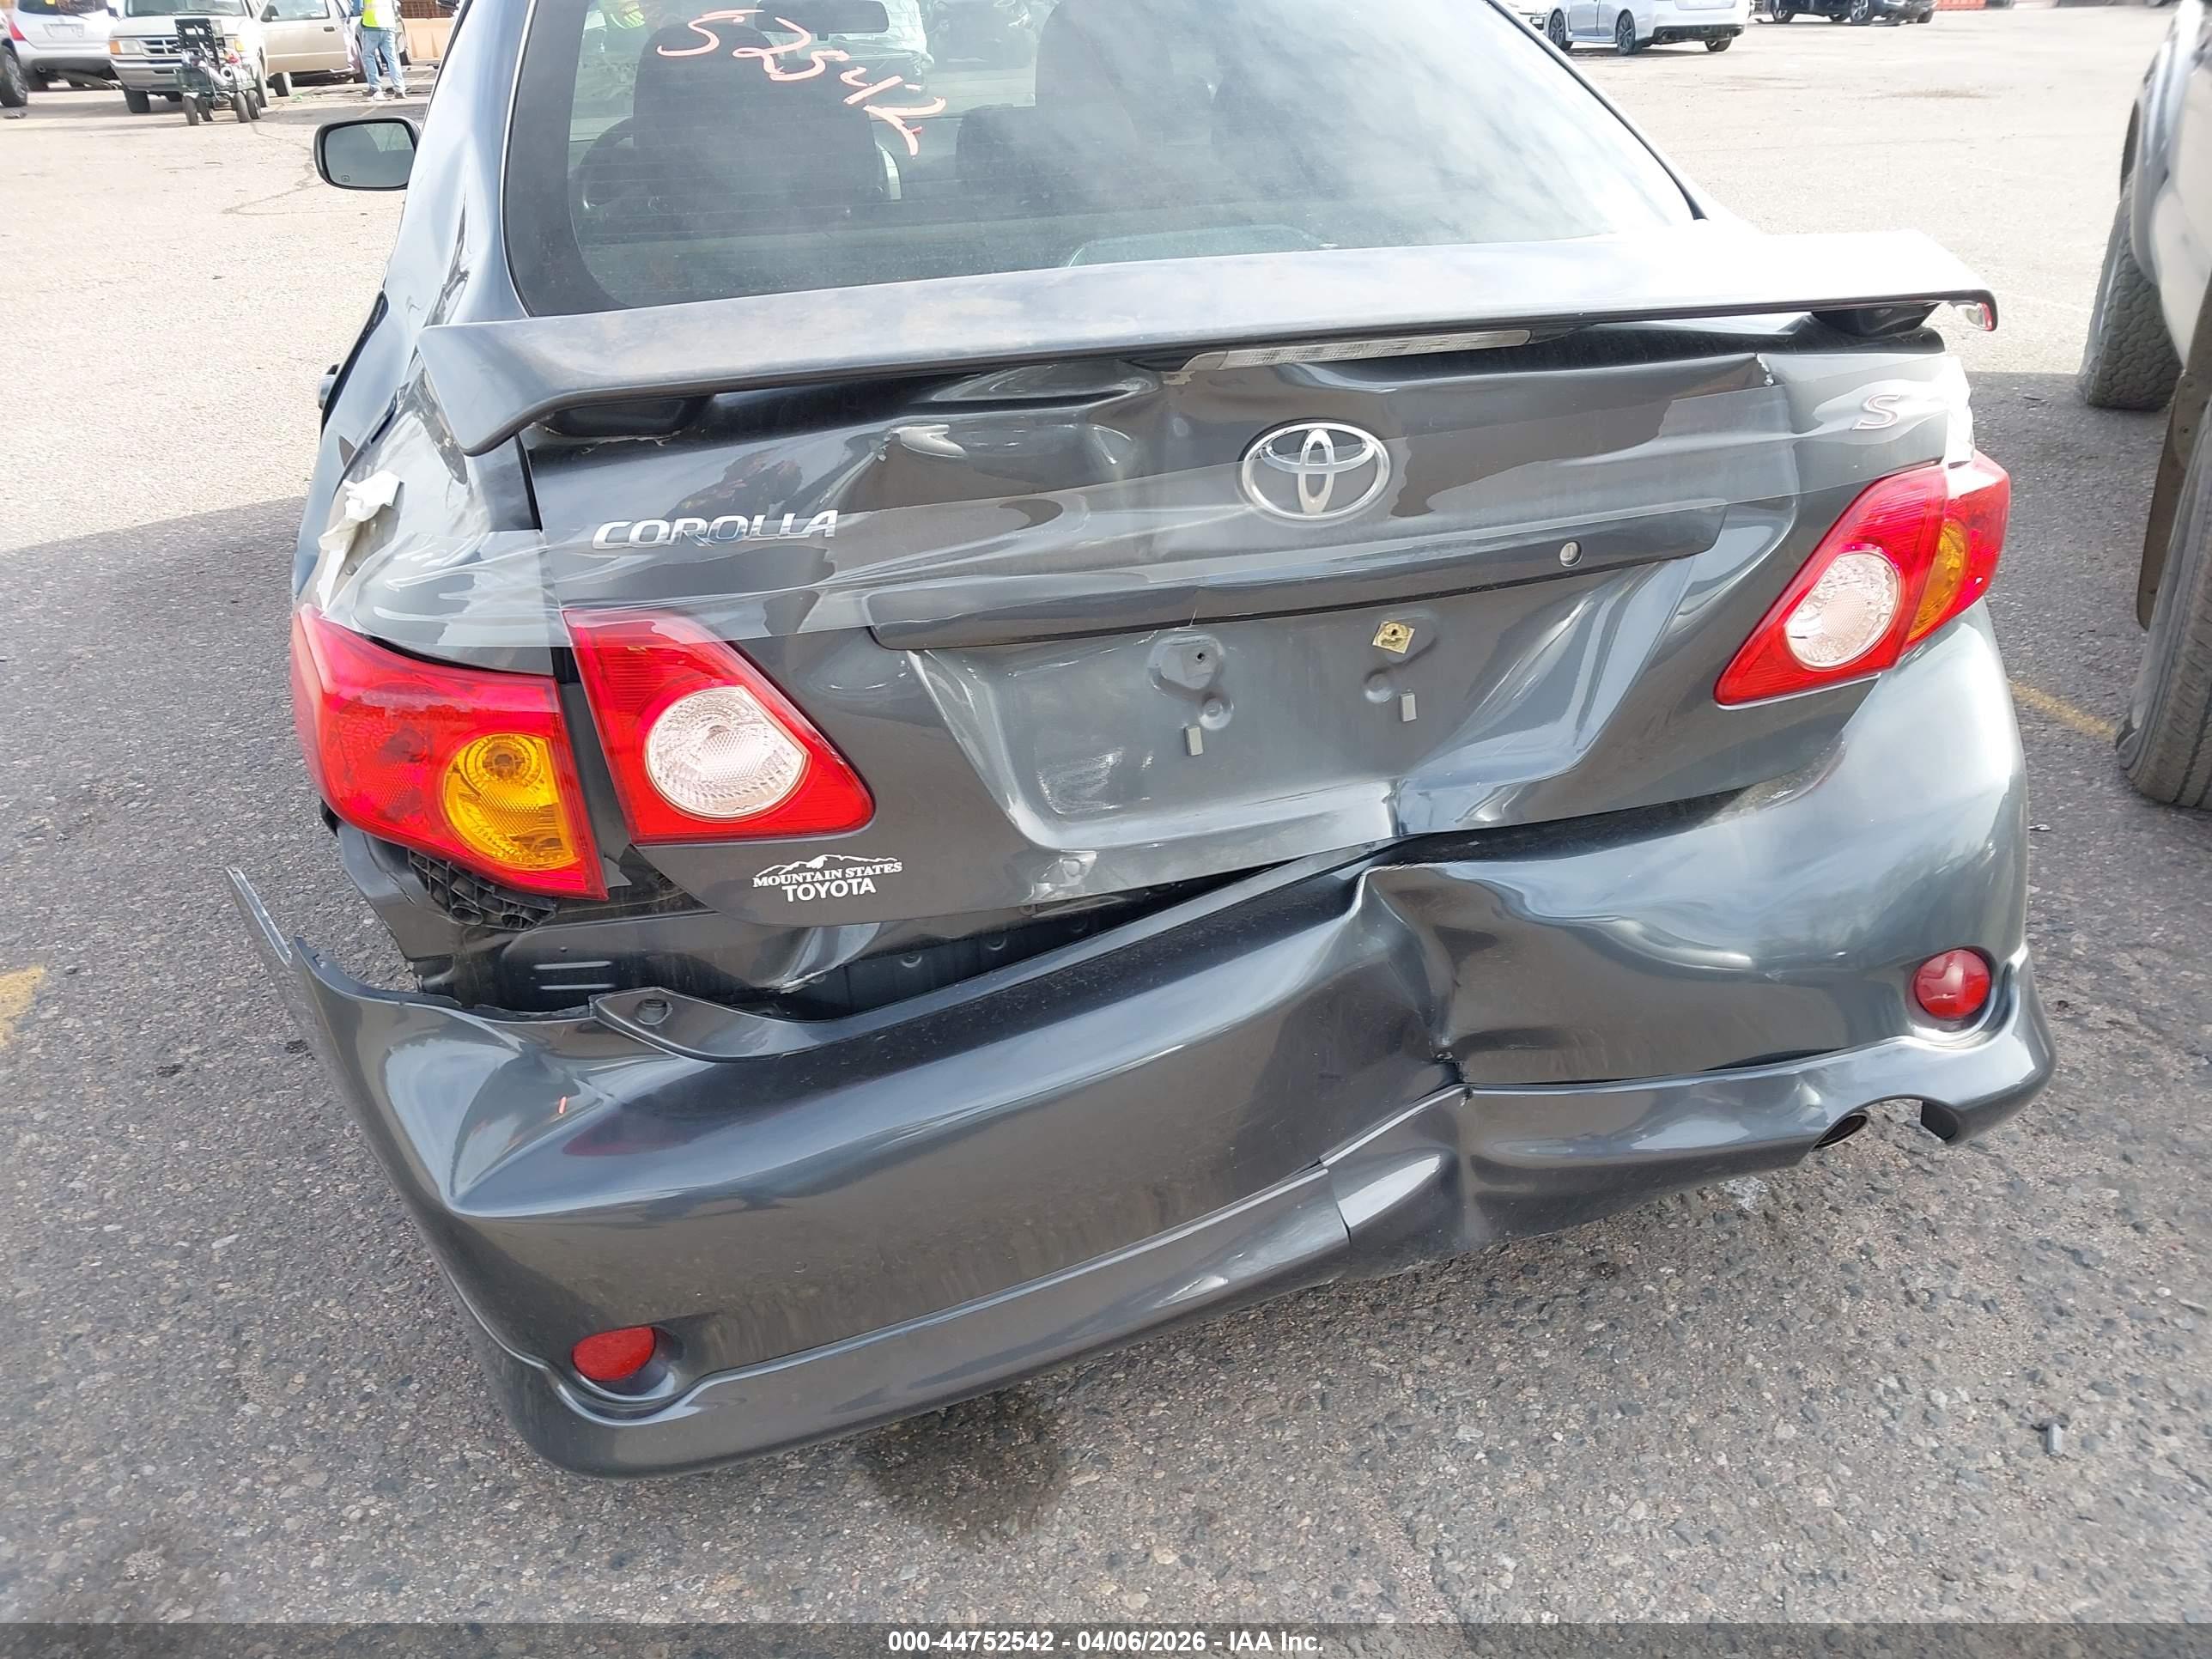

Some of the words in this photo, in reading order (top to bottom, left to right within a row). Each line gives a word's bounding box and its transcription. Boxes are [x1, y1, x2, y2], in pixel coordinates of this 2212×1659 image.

[1852, 394, 1902, 429] S
[592, 510, 839, 550] COROLLA
[752, 869, 842, 888] MOUNTAIN
[845, 861, 902, 878] STATES
[781, 877, 877, 902] TOYOTA
